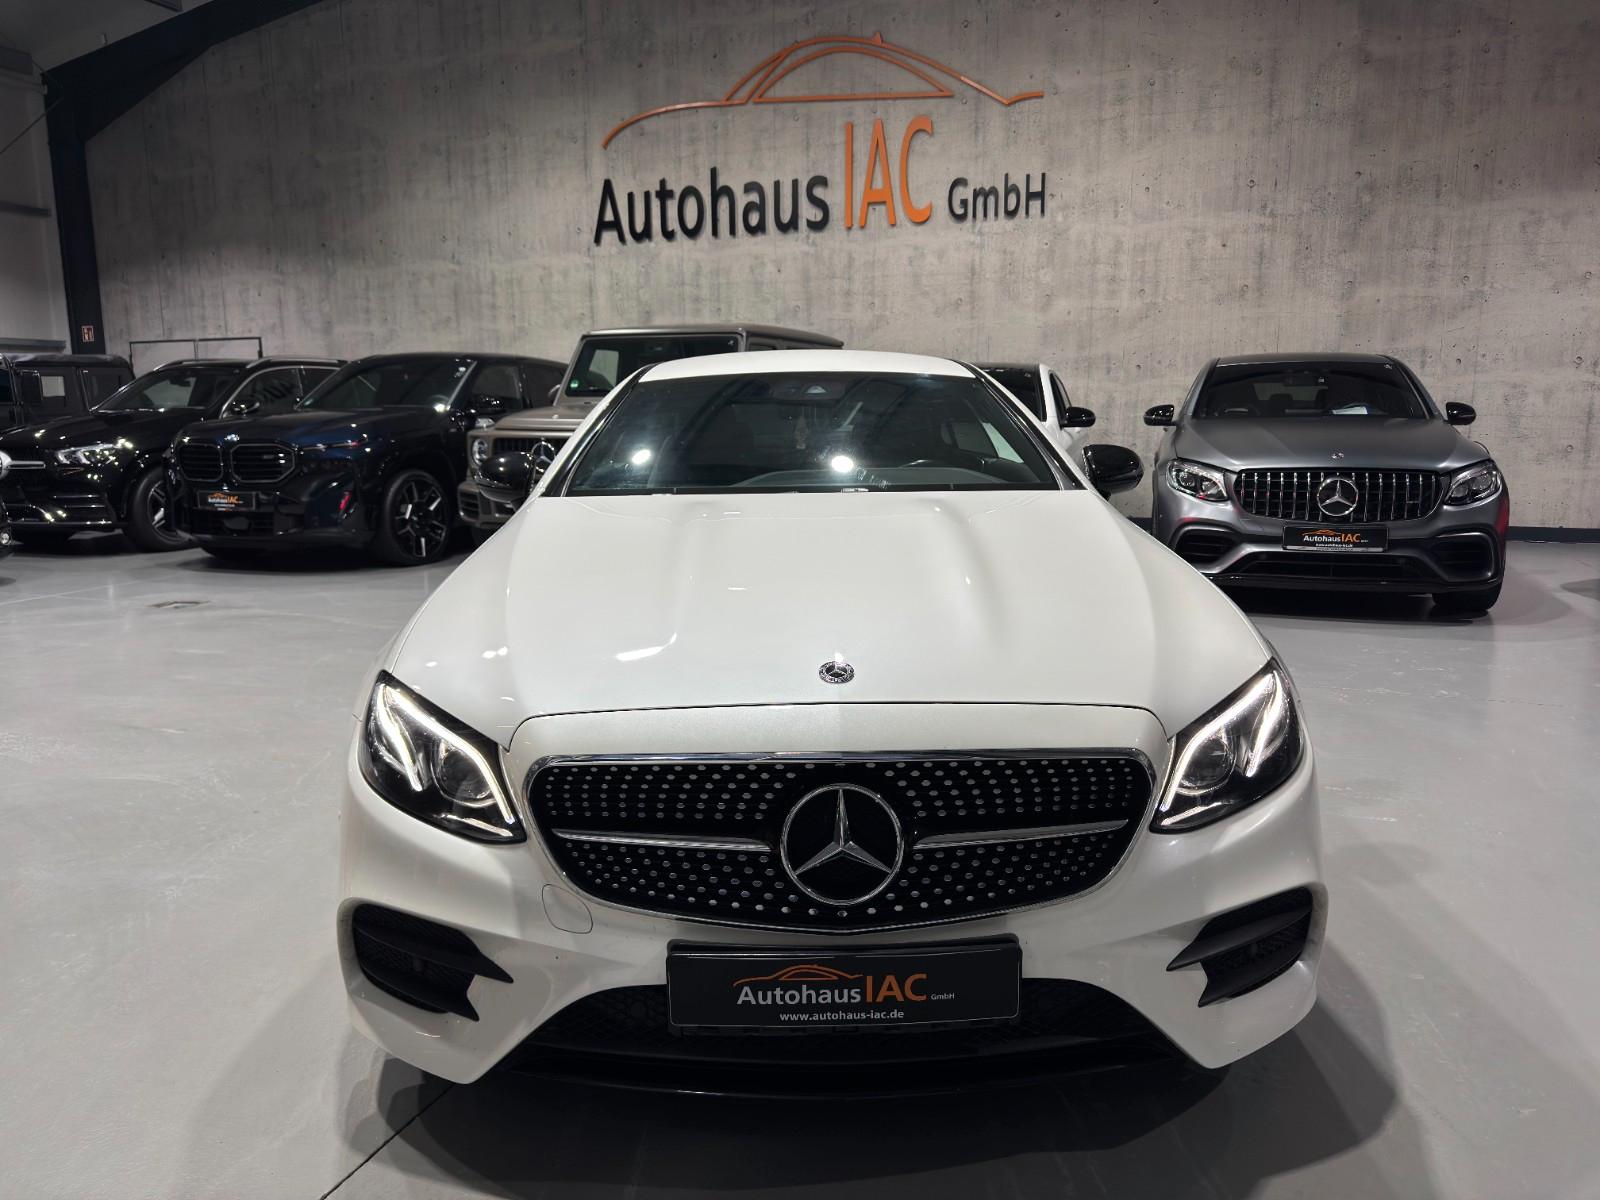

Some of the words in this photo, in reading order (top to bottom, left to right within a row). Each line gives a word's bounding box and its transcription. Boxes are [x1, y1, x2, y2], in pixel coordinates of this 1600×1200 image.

[594, 167, 830, 246] Autohaus
[844, 115, 933, 230] IAC
[947, 172, 1047, 222] GmbH
[1341, 534, 1360, 542] IAC
[737, 985, 861, 1005] Autohaus
[866, 973, 927, 1002] IAC
[930, 992, 955, 1001] GmbH
[779, 1009, 905, 1021] www.autohaus-iac.de
